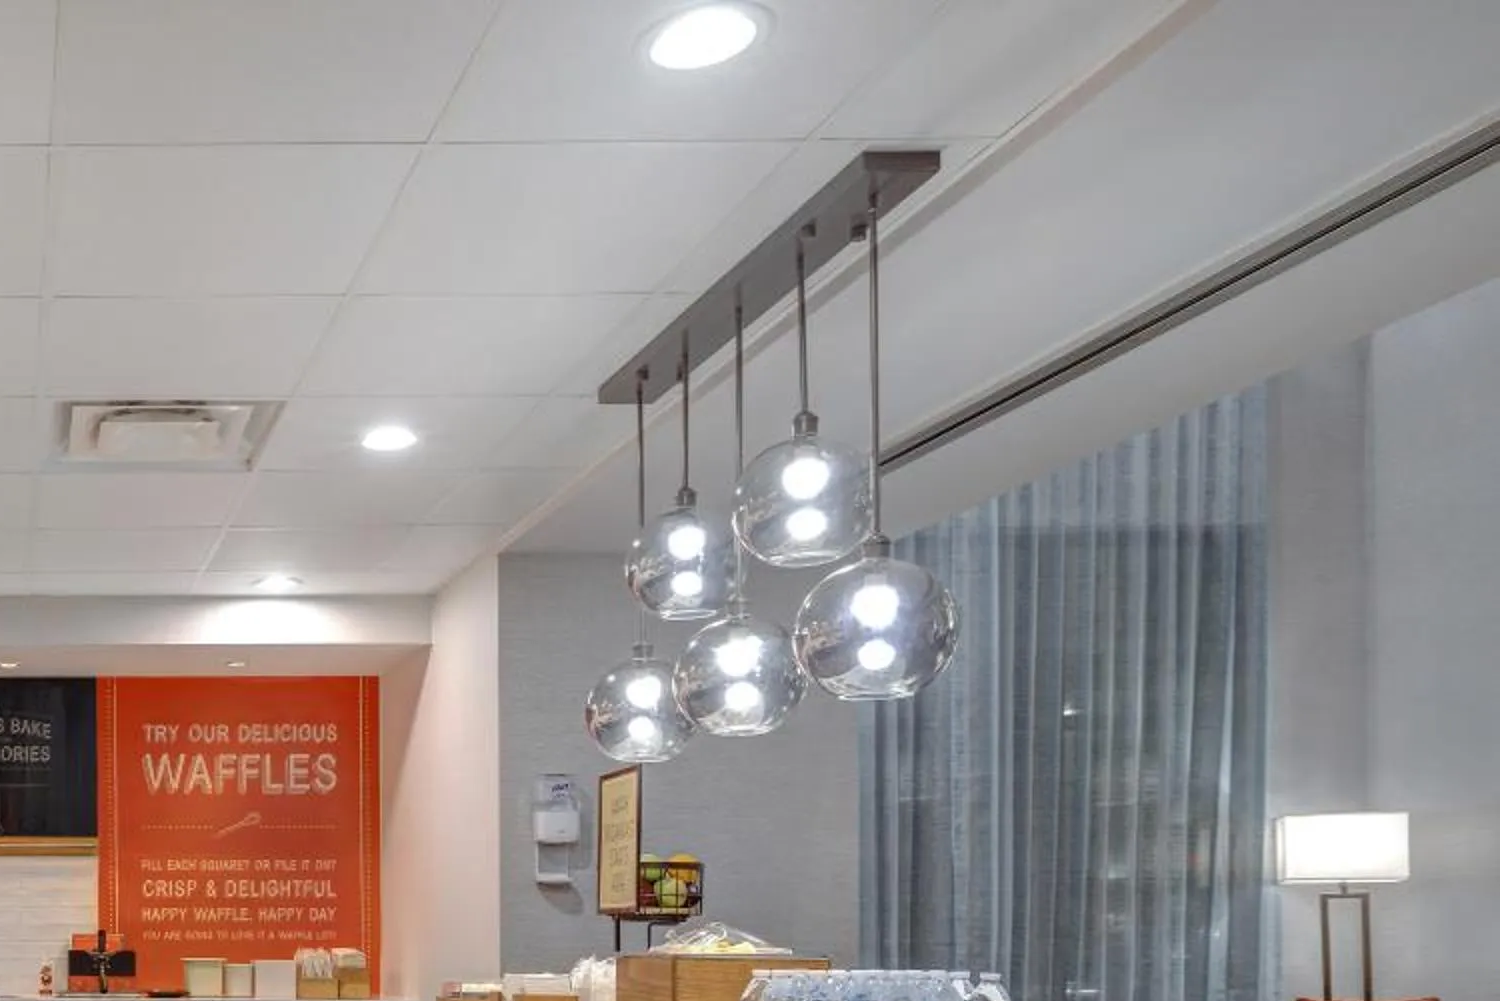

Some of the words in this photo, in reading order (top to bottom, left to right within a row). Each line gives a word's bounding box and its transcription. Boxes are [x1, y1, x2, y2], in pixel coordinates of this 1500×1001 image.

[10, 718, 52, 740] BAKE
[143, 723, 180, 743] TRY
[188, 723, 229, 743] OUR
[238, 723, 337, 743] DELICIOUS
[142, 752, 338, 795] WAFFLES
[142, 879, 198, 898] CRISP
[205, 879, 217, 898] &
[224, 879, 338, 898] DELIGHTFUL
[141, 907, 188, 922] HAPPY
[258, 907, 303, 922] HAPPY
[308, 907, 338, 922] DAY
